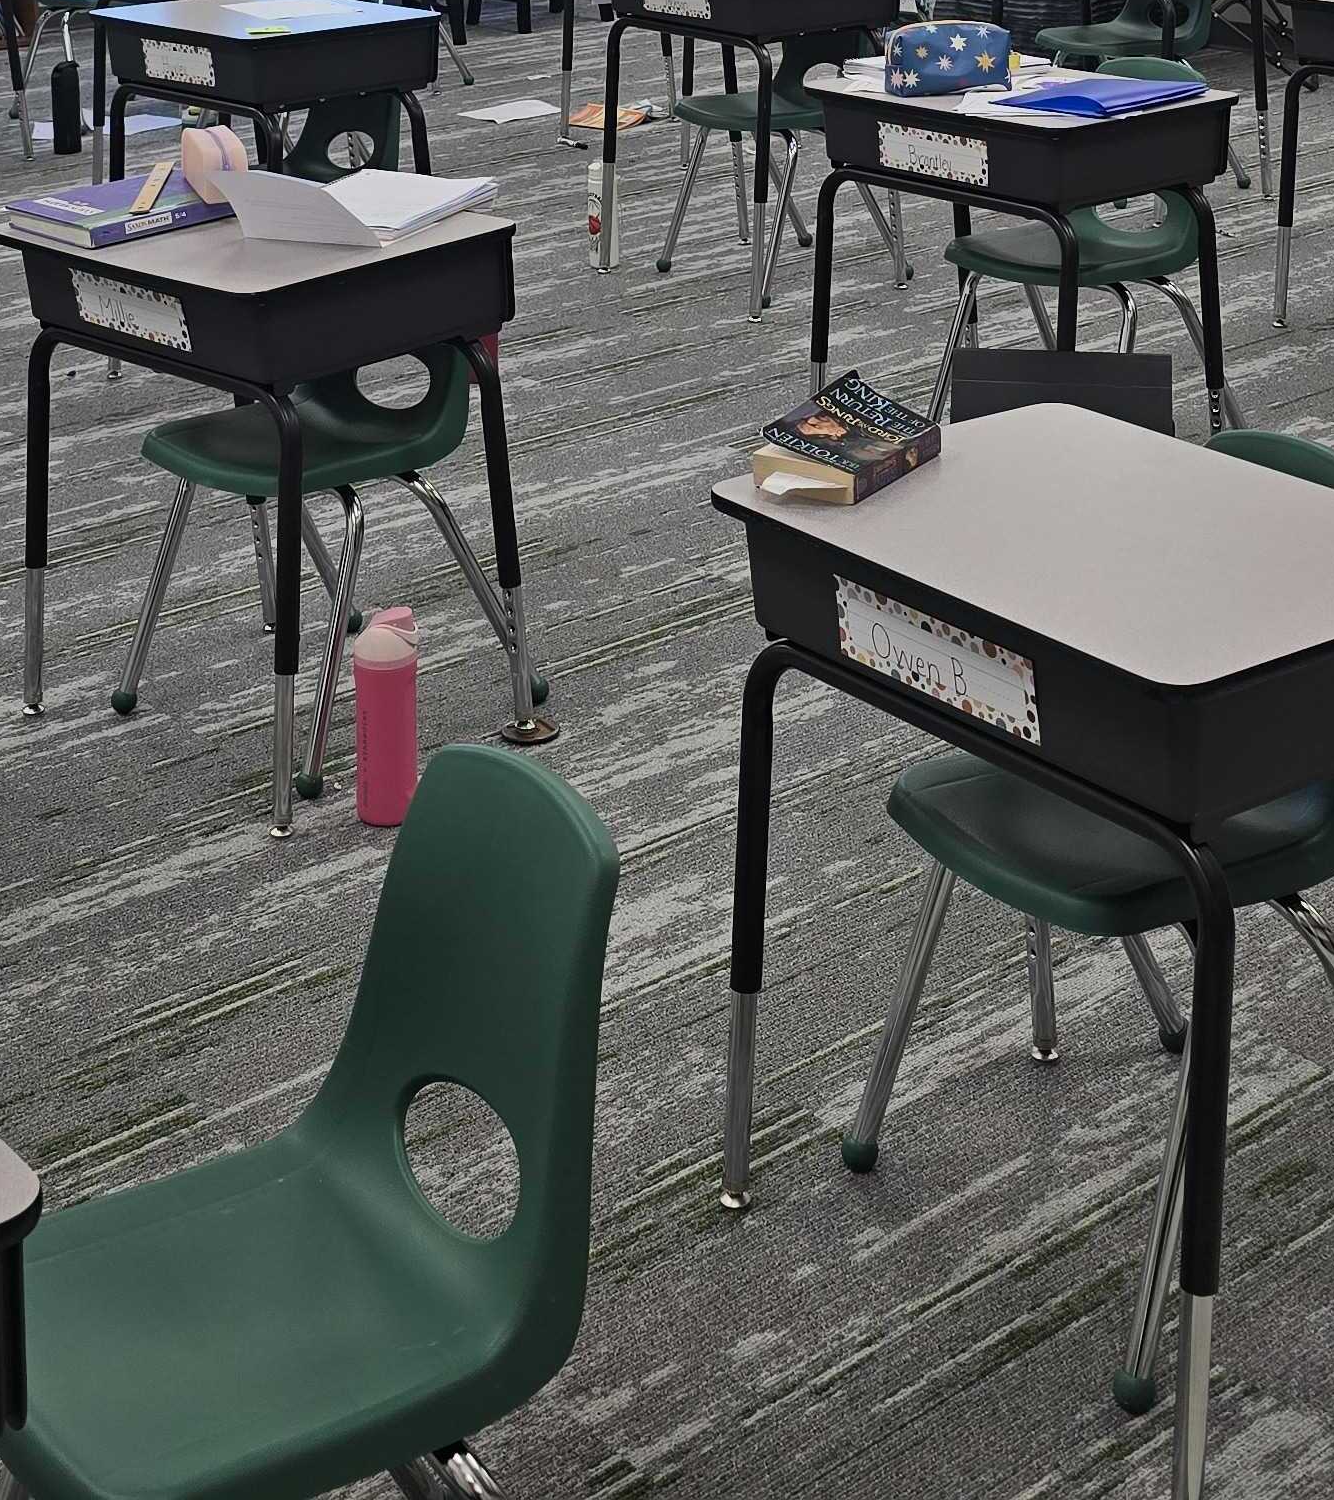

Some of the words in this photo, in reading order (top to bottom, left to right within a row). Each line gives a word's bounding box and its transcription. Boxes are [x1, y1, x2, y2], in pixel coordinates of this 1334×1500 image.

[816, 396, 860, 427] RINGS
[830, 387, 890, 429] RETURN
[844, 378, 891, 412] KING
[768, 427, 839, 462] TOLKIEN
[867, 426, 907, 445] LORD
[871, 622, 942, 684] Owen
[950, 656, 968, 696] B
